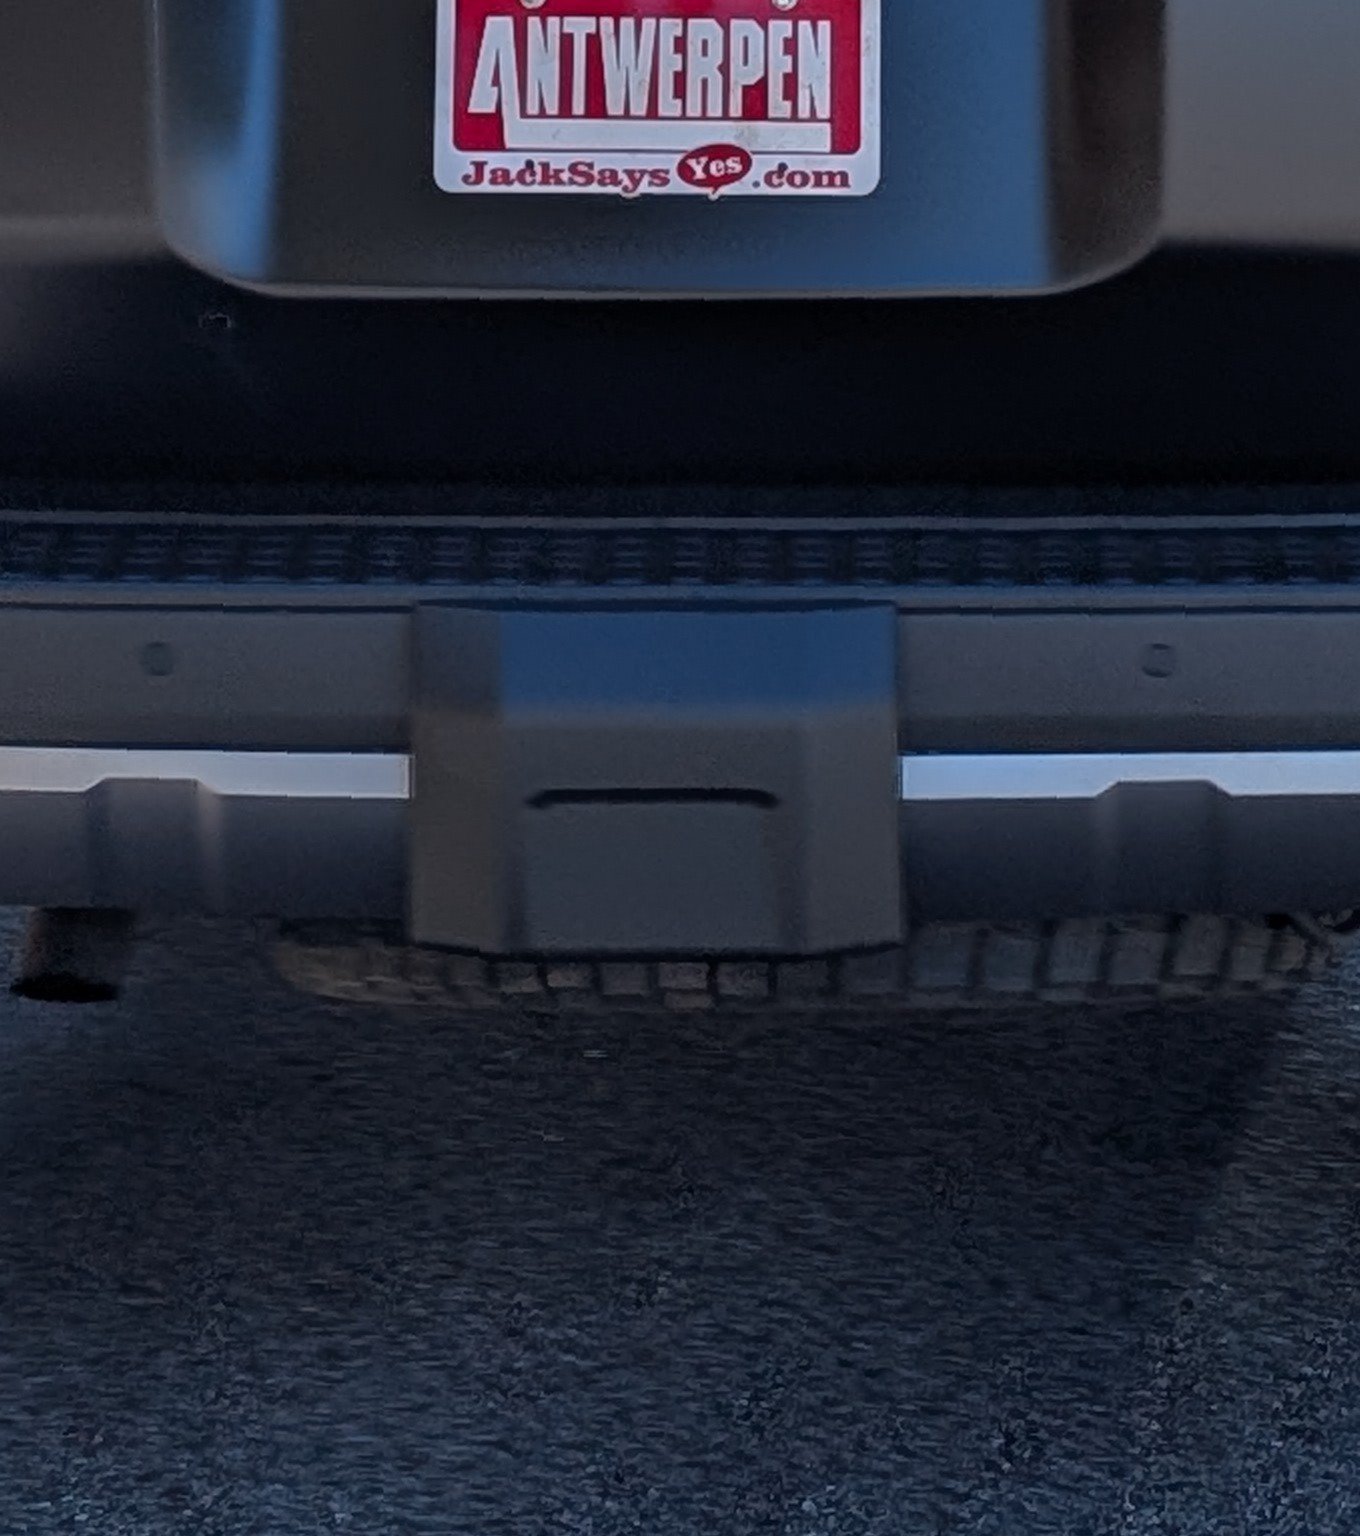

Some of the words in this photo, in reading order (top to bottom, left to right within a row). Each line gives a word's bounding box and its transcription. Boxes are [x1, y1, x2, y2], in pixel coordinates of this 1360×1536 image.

[467, 16, 832, 124] ANTWERPEN
[461, 160, 670, 193] JackSays
[686, 154, 744, 180] Yes
[752, 163, 851, 190] .com
